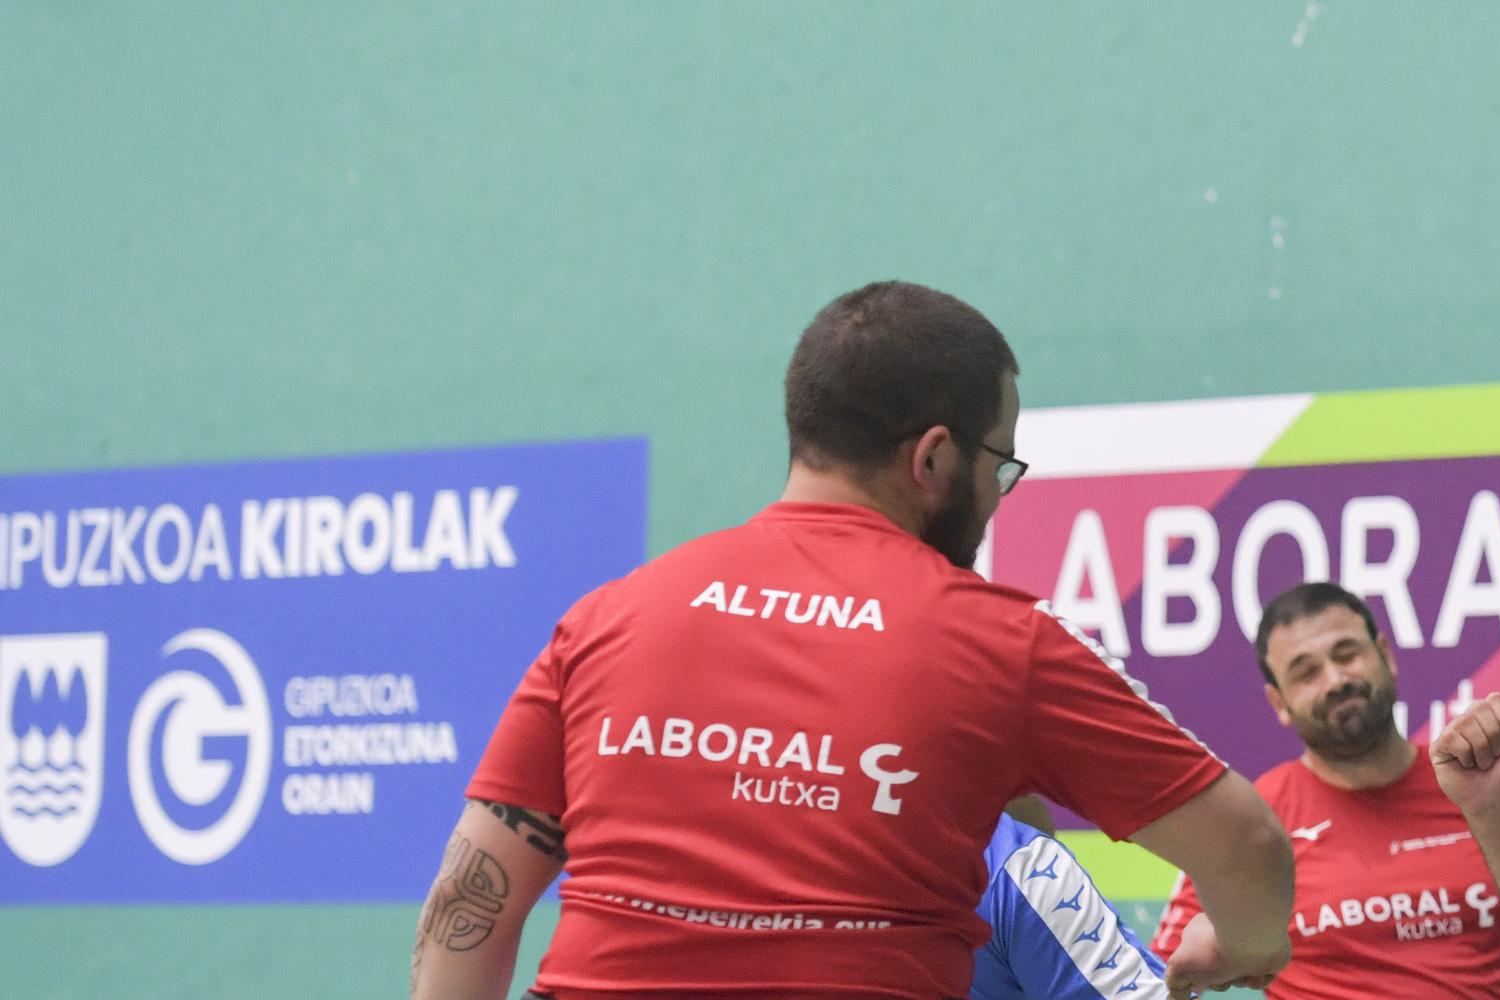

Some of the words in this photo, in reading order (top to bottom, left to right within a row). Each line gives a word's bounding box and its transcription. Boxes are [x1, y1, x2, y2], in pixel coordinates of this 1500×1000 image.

[241, 486, 519, 579] KIROLAK
[690, 581, 885, 632] ALTUNA
[597, 715, 846, 775] LABORAL
[282, 773, 374, 814] ORAIN
[732, 772, 841, 811] kutxa
[1295, 887, 1461, 937] LABORAL
[1396, 917, 1463, 941] kutxa
